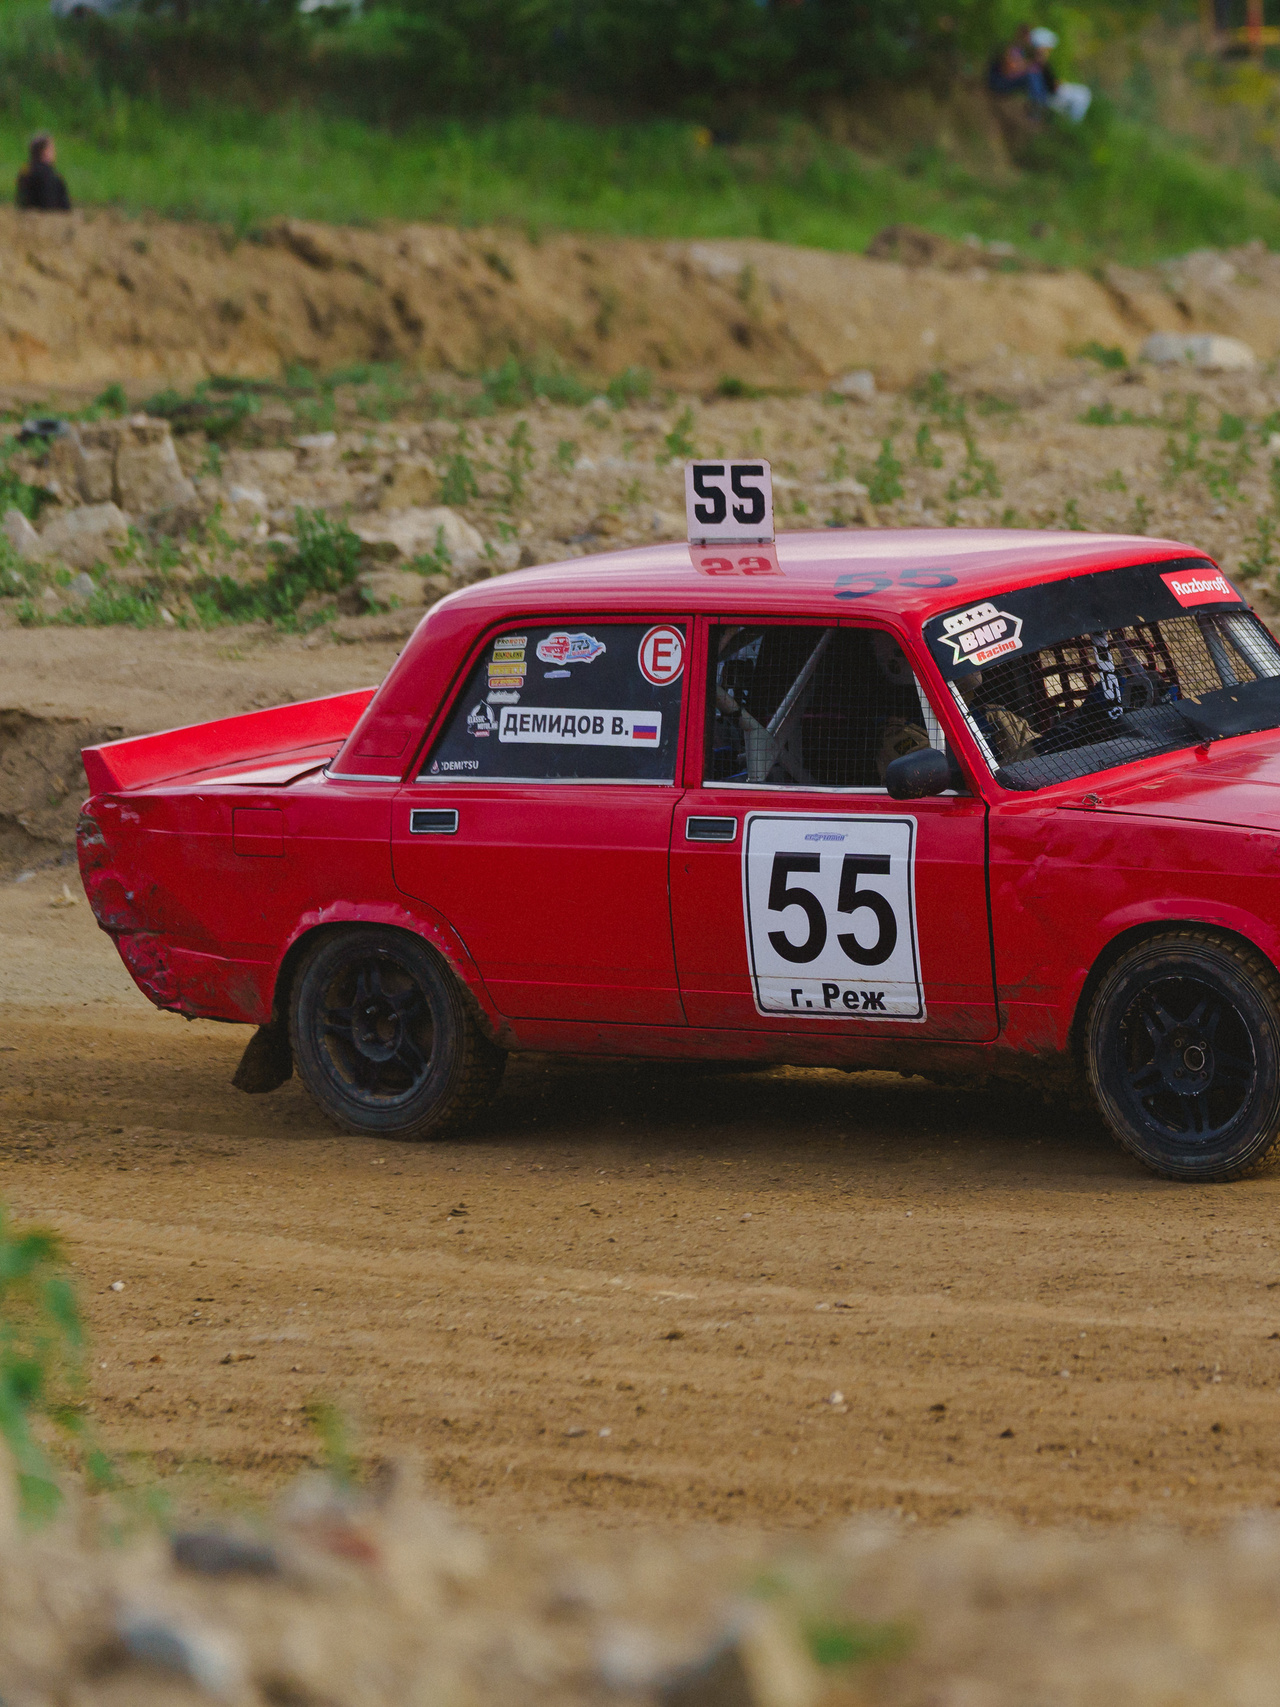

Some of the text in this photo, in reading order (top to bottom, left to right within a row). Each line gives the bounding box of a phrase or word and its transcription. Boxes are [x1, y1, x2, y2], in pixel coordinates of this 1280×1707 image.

[693, 465, 765, 524] 55
[833, 567, 959, 600] 55
[1171, 577, 1230, 596] Razboroff
[958, 619, 1007, 653] BNP
[976, 640, 1016, 662] Racing
[652, 638, 673, 672] E
[503, 713, 629, 737] ДЕМИДОВ В.
[767, 851, 897, 966] 55
[790, 983, 886, 1011] г. Реж
